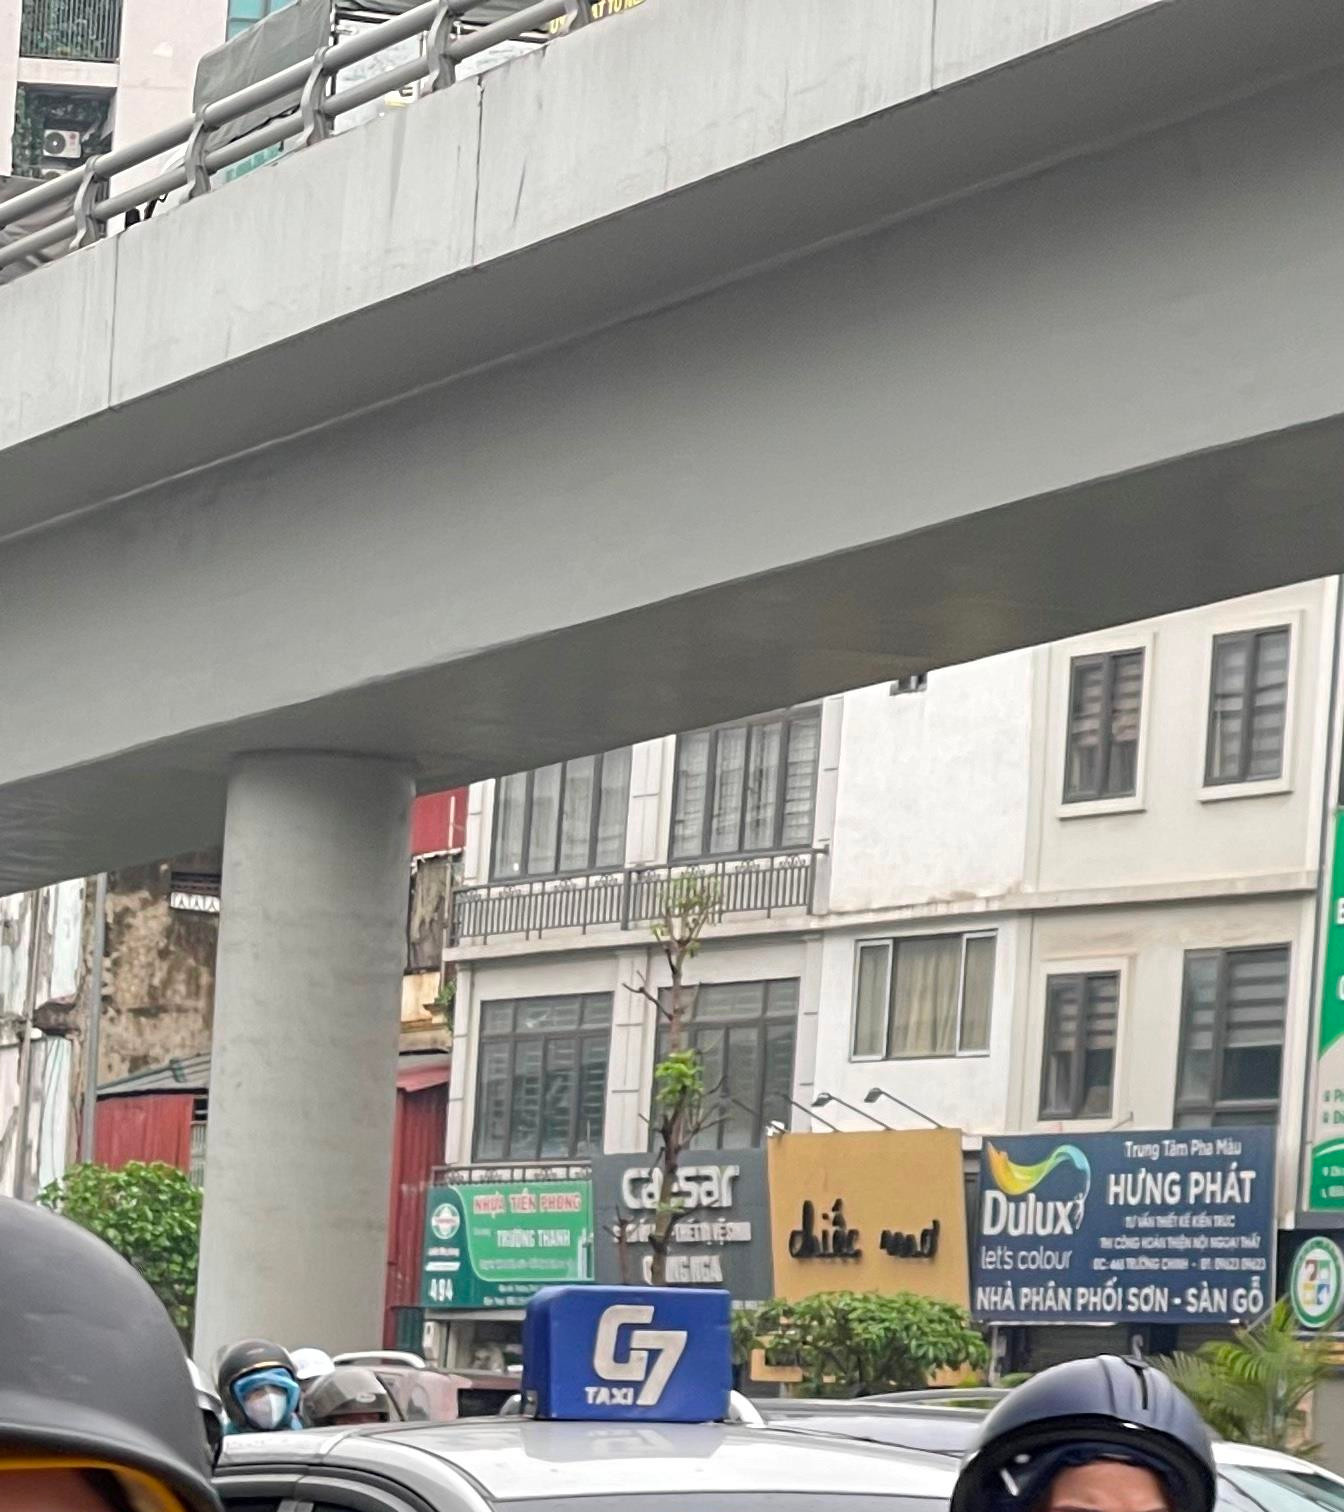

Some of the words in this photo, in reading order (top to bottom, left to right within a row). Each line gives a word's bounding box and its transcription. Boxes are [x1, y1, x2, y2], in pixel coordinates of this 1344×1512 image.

[622, 1165, 740, 1209] casar
[1108, 1167, 1181, 1206] HƯNG
[1188, 1162, 1256, 1204] PHÁT
[983, 1189, 1074, 1236] Dulux
[981, 1244, 1013, 1270] let's
[1017, 1244, 1072, 1270] colour
[976, 1280, 1015, 1311] NHÀ
[1019, 1280, 1072, 1311] PHÂN
[1076, 1276, 1123, 1312] PHỐI
[1127, 1285, 1168, 1312] SƠN
[1186, 1281, 1228, 1313] SÀN
[1232, 1276, 1264, 1314] GỖ
[593, 1304, 688, 1406] G7
[584, 1386, 634, 1406] TAXI
